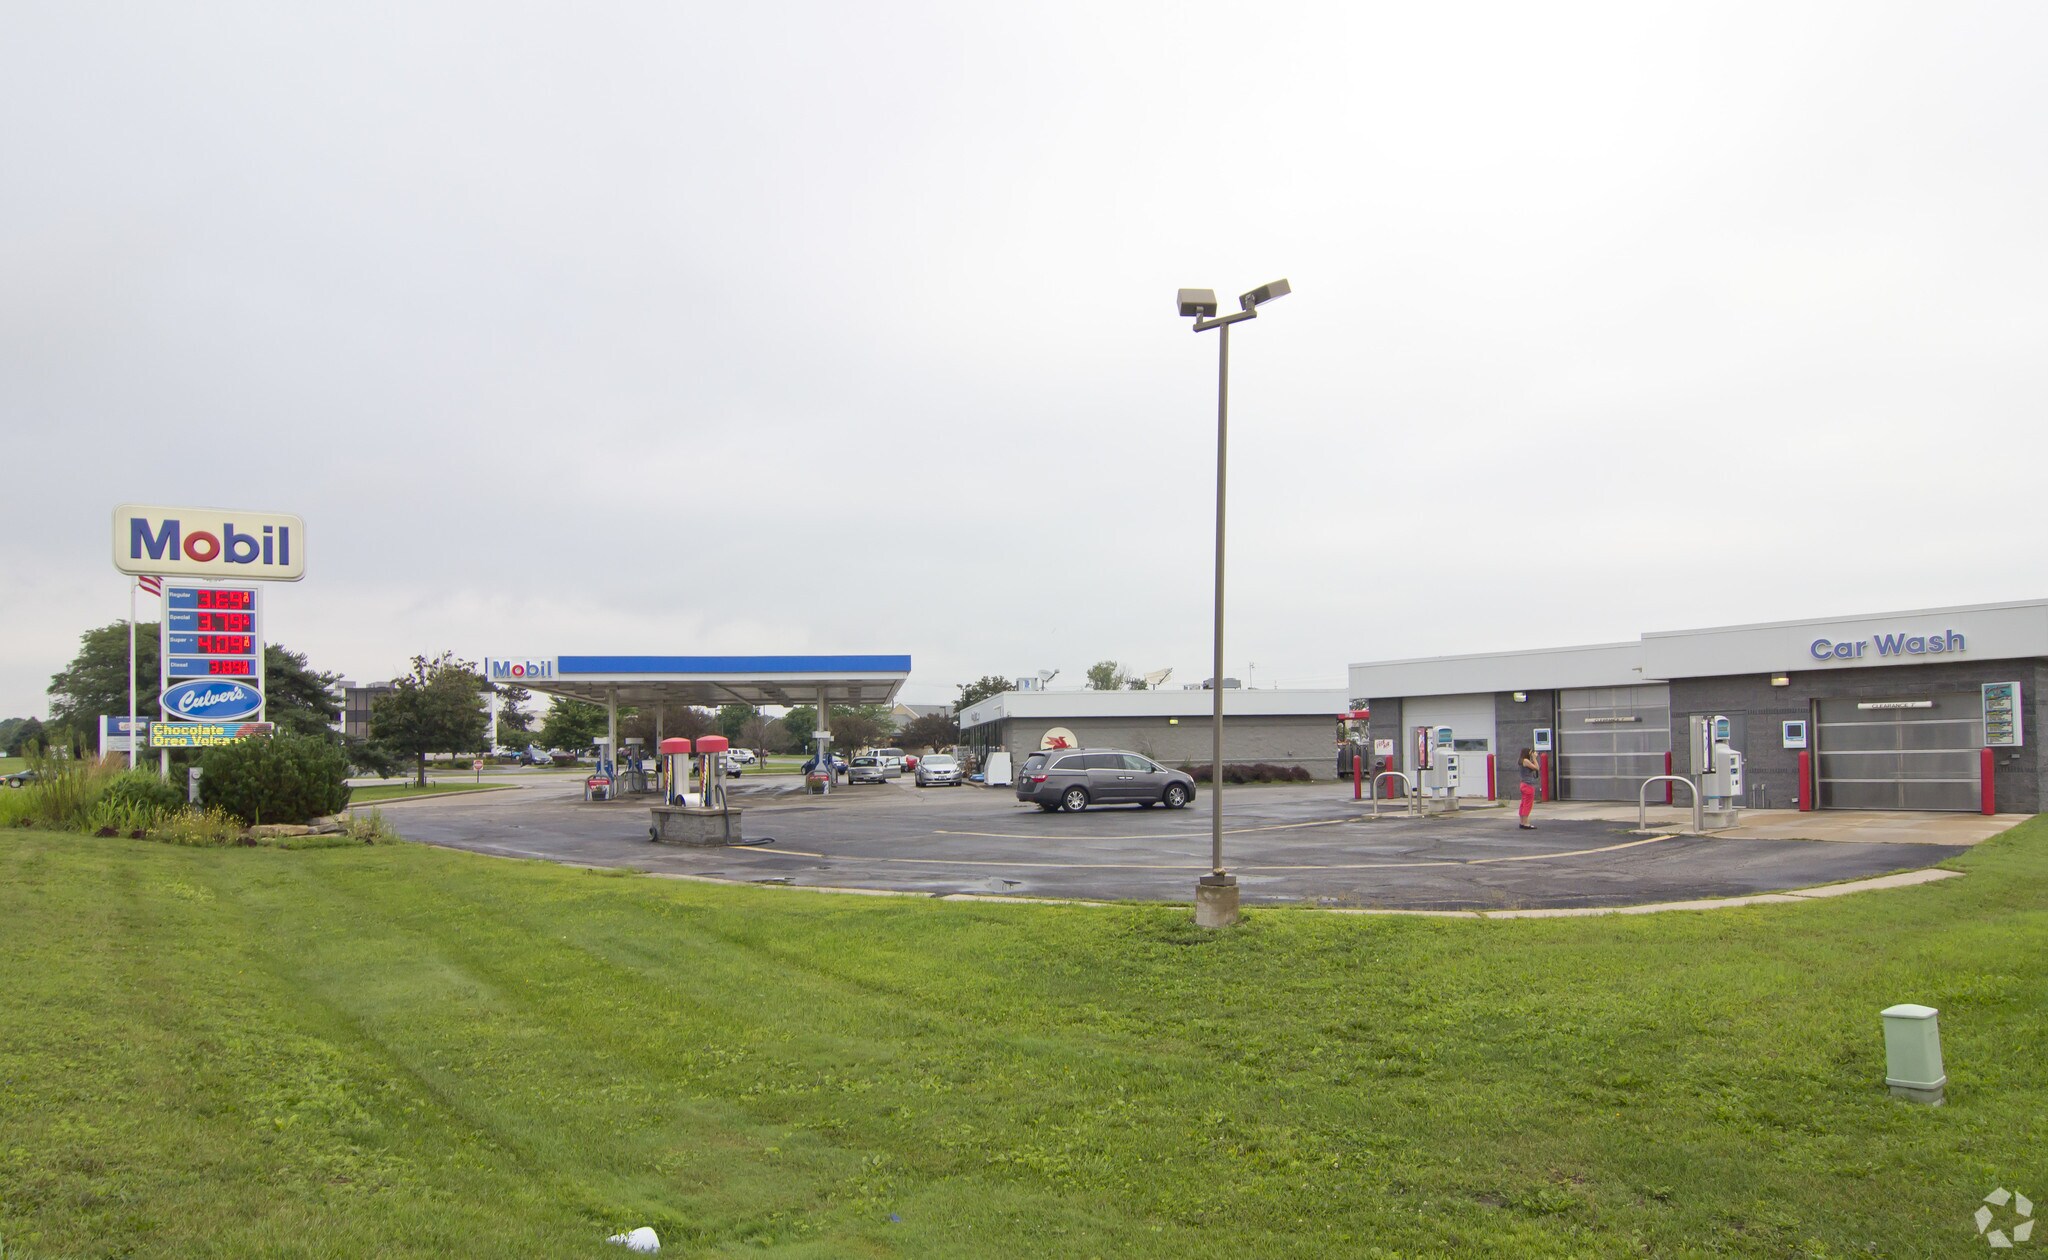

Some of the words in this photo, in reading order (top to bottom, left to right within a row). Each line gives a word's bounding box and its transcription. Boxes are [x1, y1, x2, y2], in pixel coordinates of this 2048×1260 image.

[130, 517, 290, 566] Mobil
[197, 612, 243, 632] 3.79
[197, 635, 243, 654] 4.09
[1810, 638, 1867, 660] Car
[1873, 629, 1966, 656] Wash
[493, 660, 552, 678] Mobil
[178, 686, 245, 713] Culver's
[153, 724, 225, 735] Chocolate
[153, 735, 187, 746] Oreo
